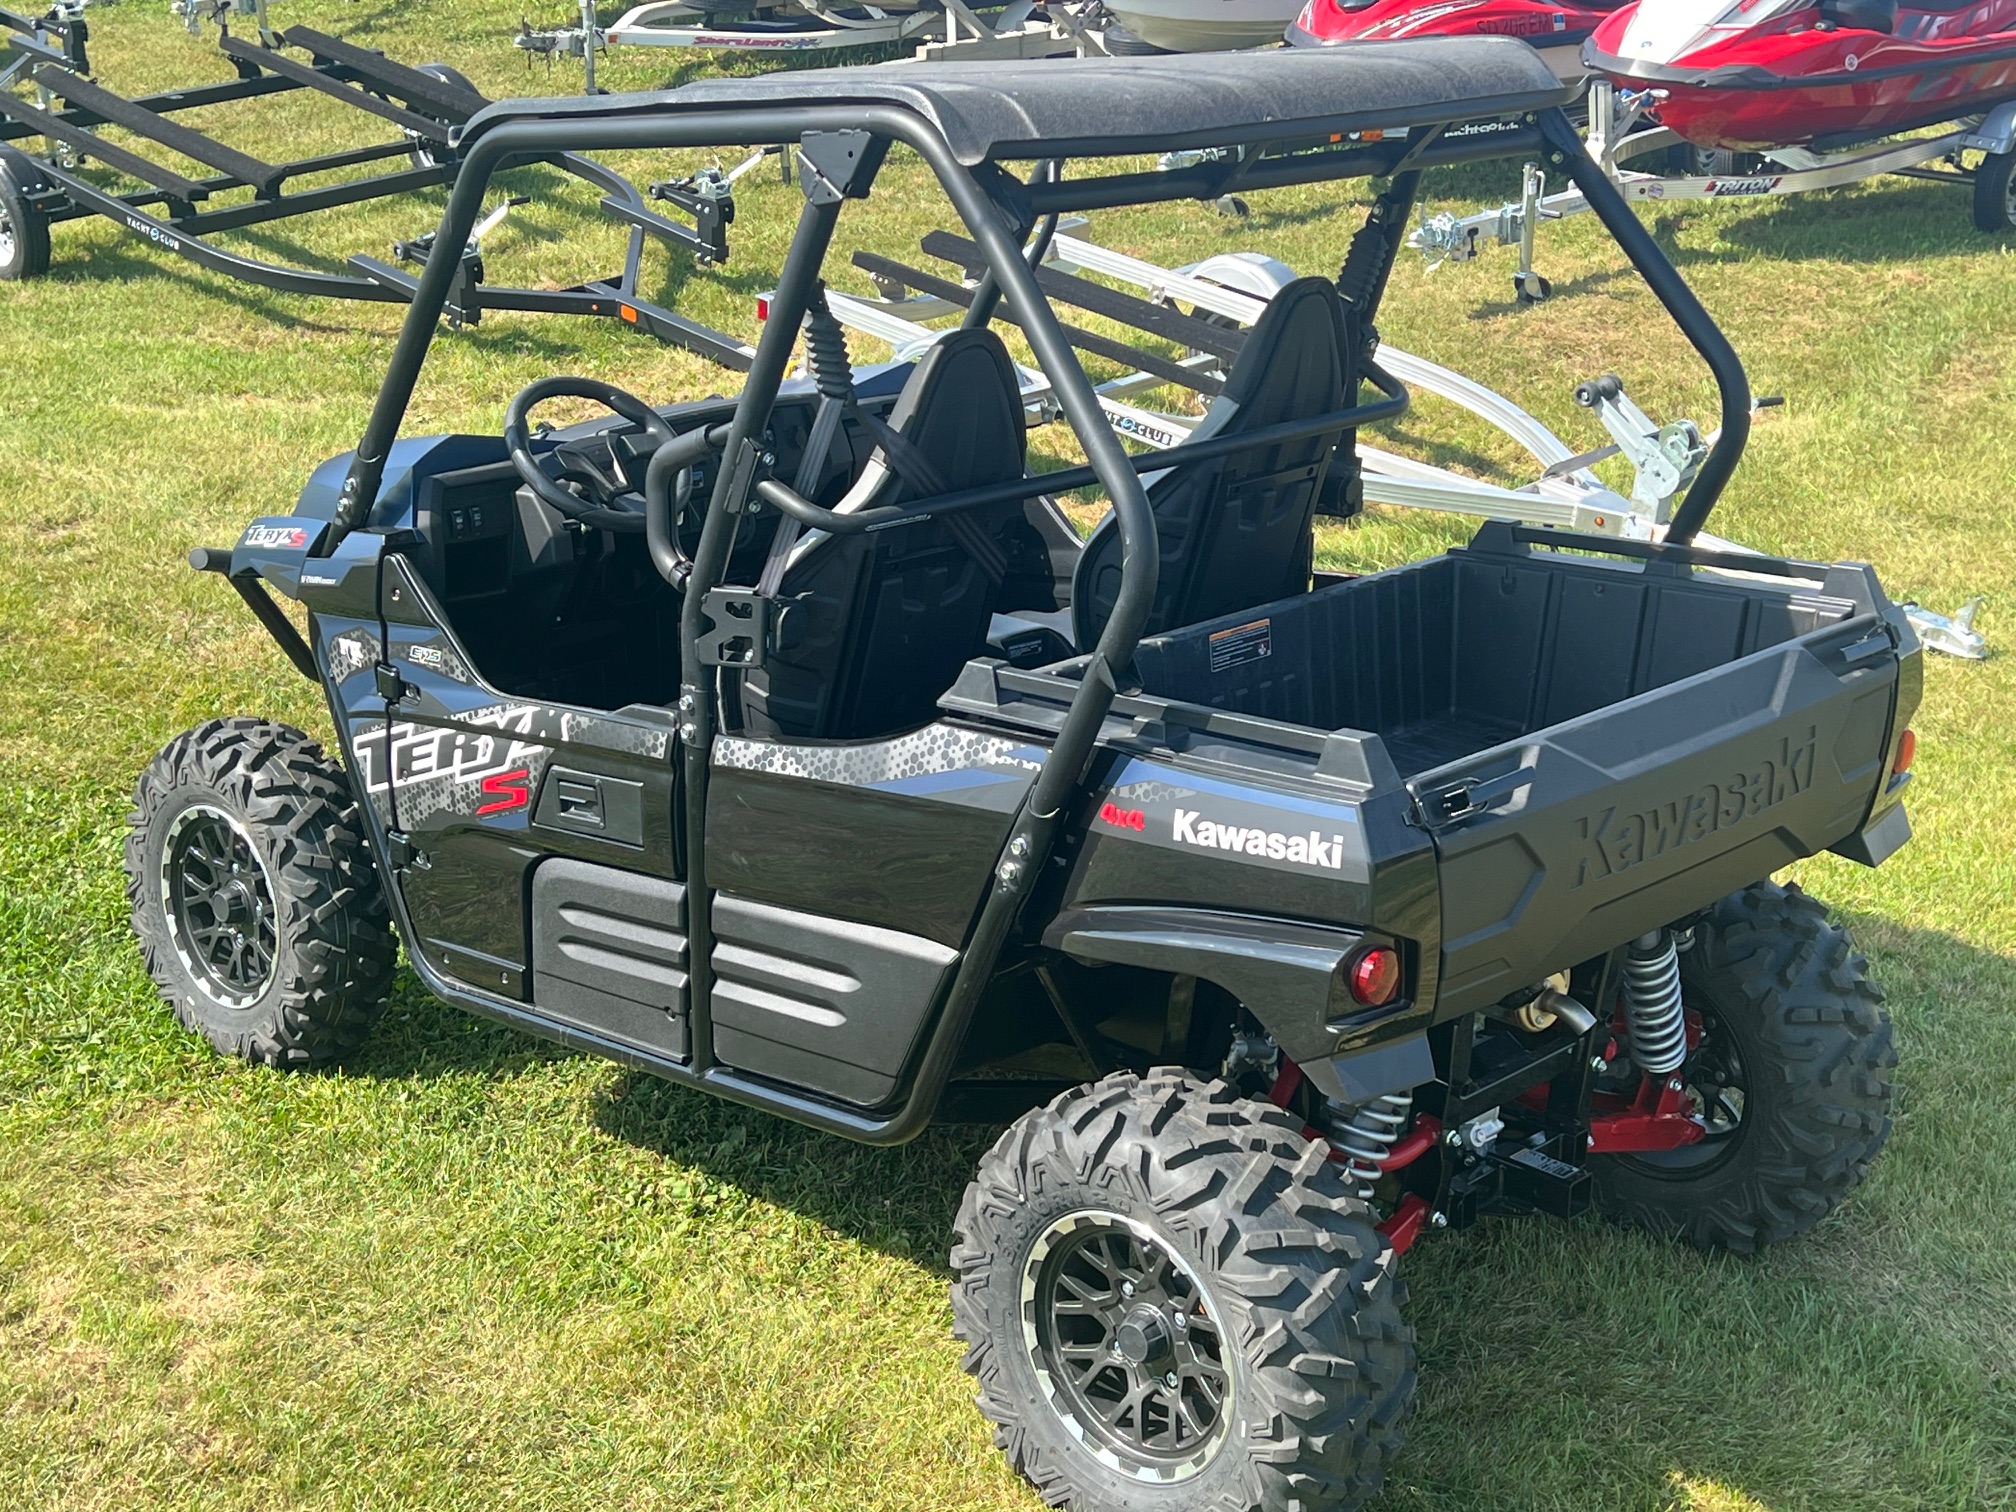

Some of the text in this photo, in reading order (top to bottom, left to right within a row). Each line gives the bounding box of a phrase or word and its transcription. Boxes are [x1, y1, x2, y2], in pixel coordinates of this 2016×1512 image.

[1713, 178, 1775, 192] TRITON
[126, 215, 180, 251] YACHT CLUB
[1137, 425, 1172, 446] CLUB
[475, 769, 528, 815] S
[1568, 724, 1818, 891] Kawasaki
[1100, 802, 1344, 870] 4x4 Kawasaki
